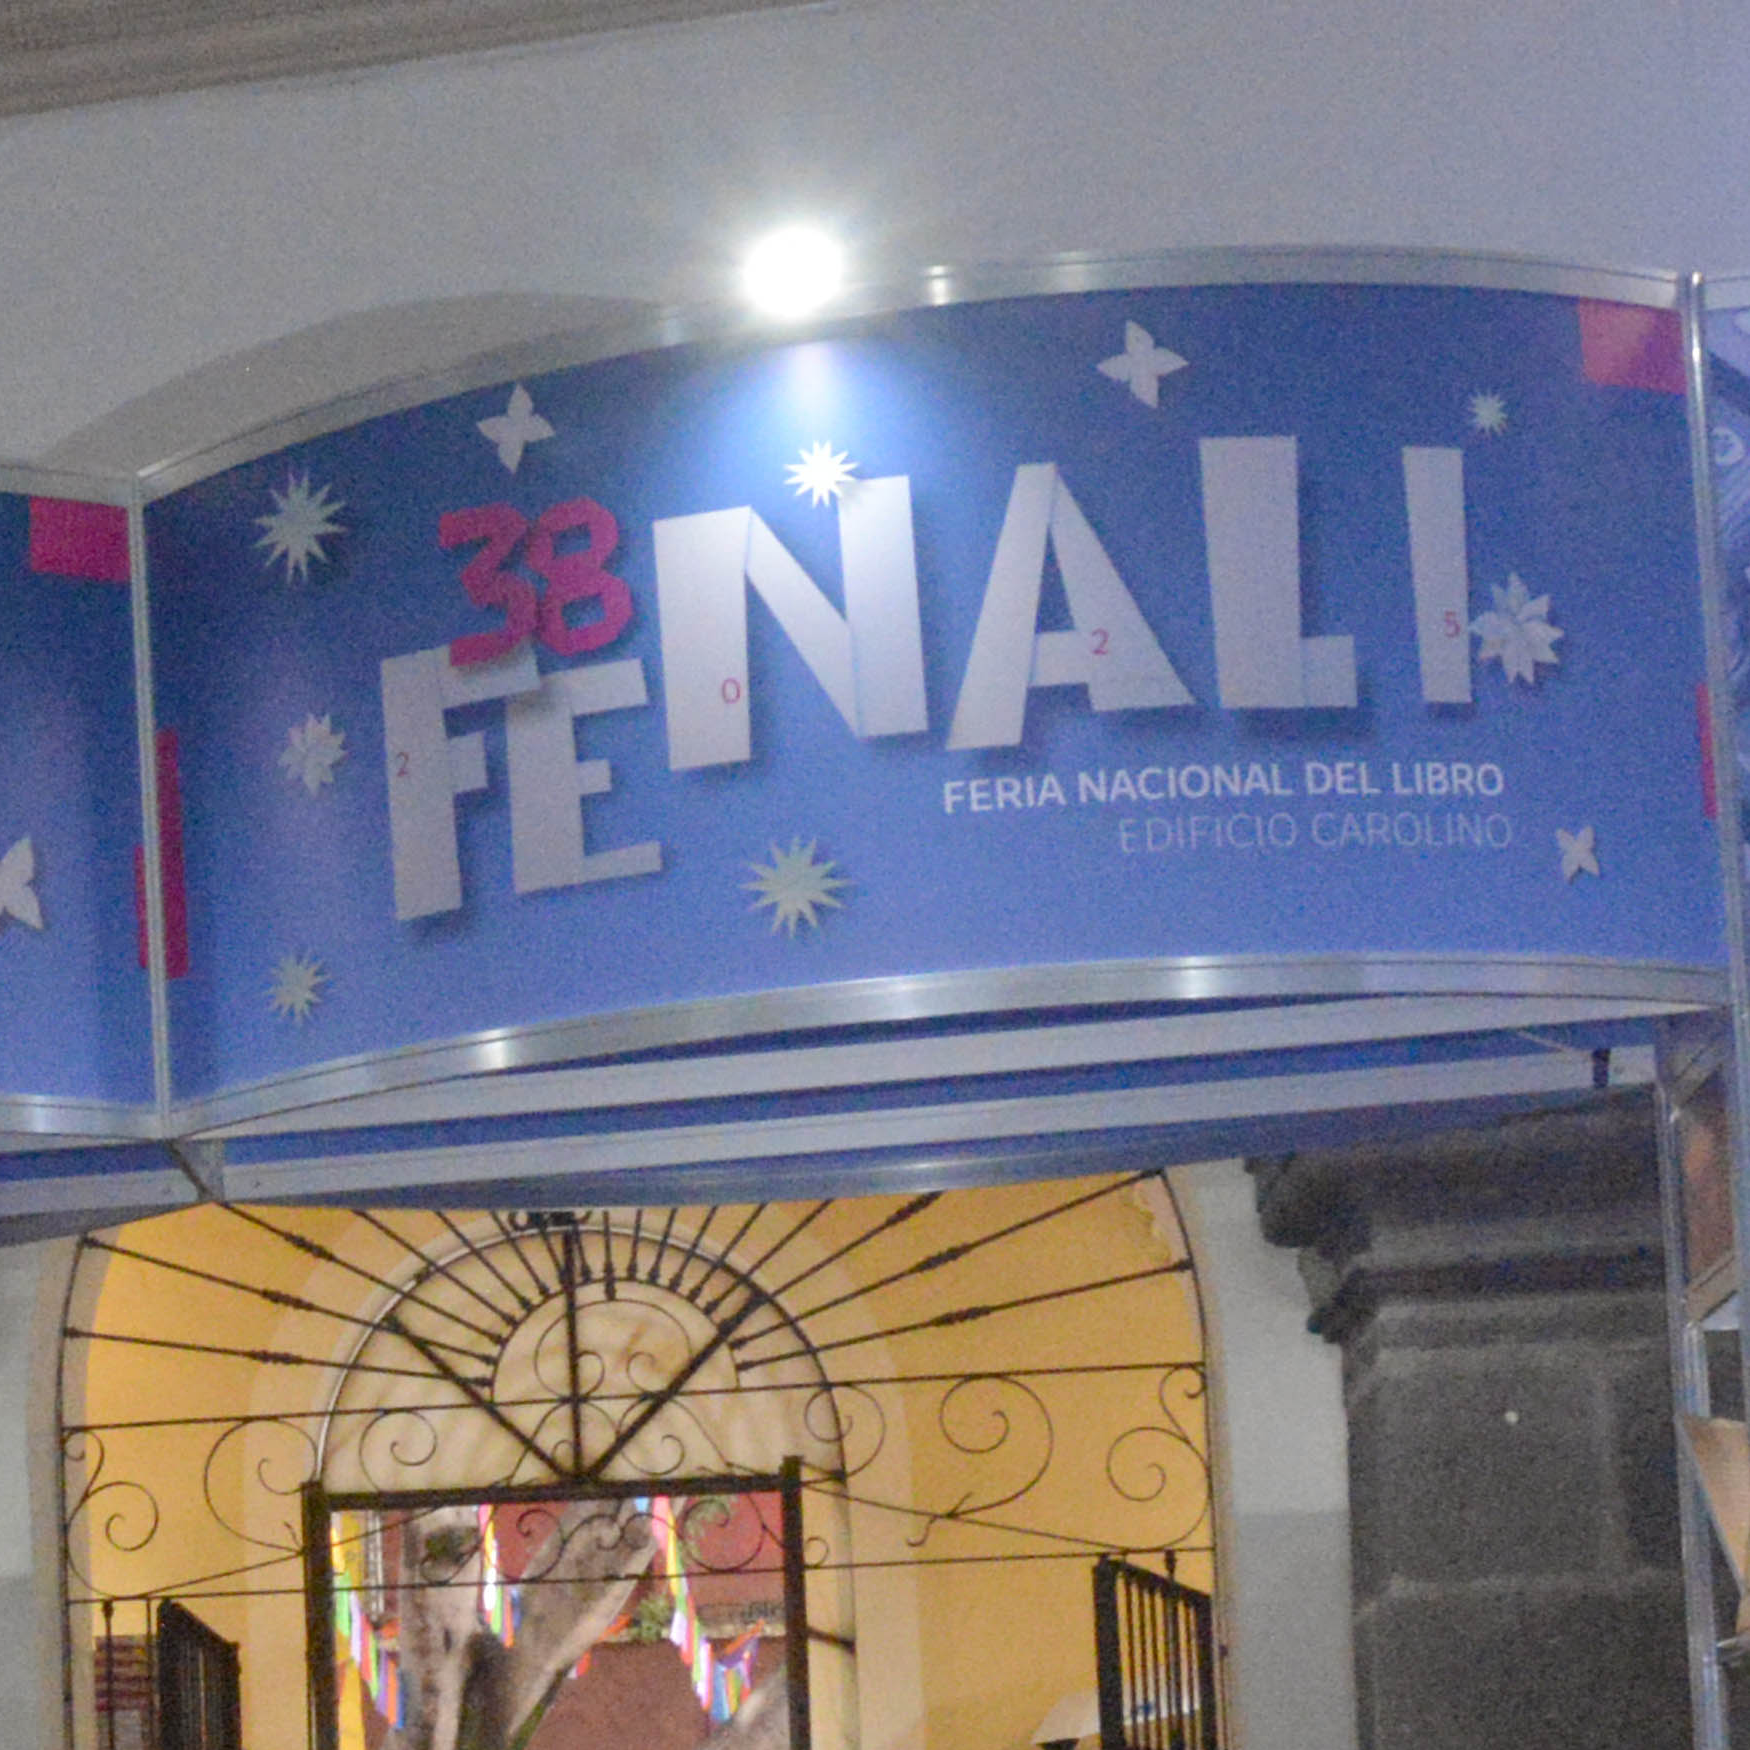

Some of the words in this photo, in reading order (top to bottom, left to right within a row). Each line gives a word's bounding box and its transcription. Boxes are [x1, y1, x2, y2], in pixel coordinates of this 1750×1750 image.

[438, 497, 633, 668] 38
[943, 775, 1066, 814] FERIA
[1078, 760, 1295, 806] NACIONAL
[1306, 761, 1382, 797] DEL
[1392, 762, 1504, 797] LIBRO
[1119, 811, 1298, 853] EDIFICIO
[1311, 811, 1513, 849] CAROLINO
